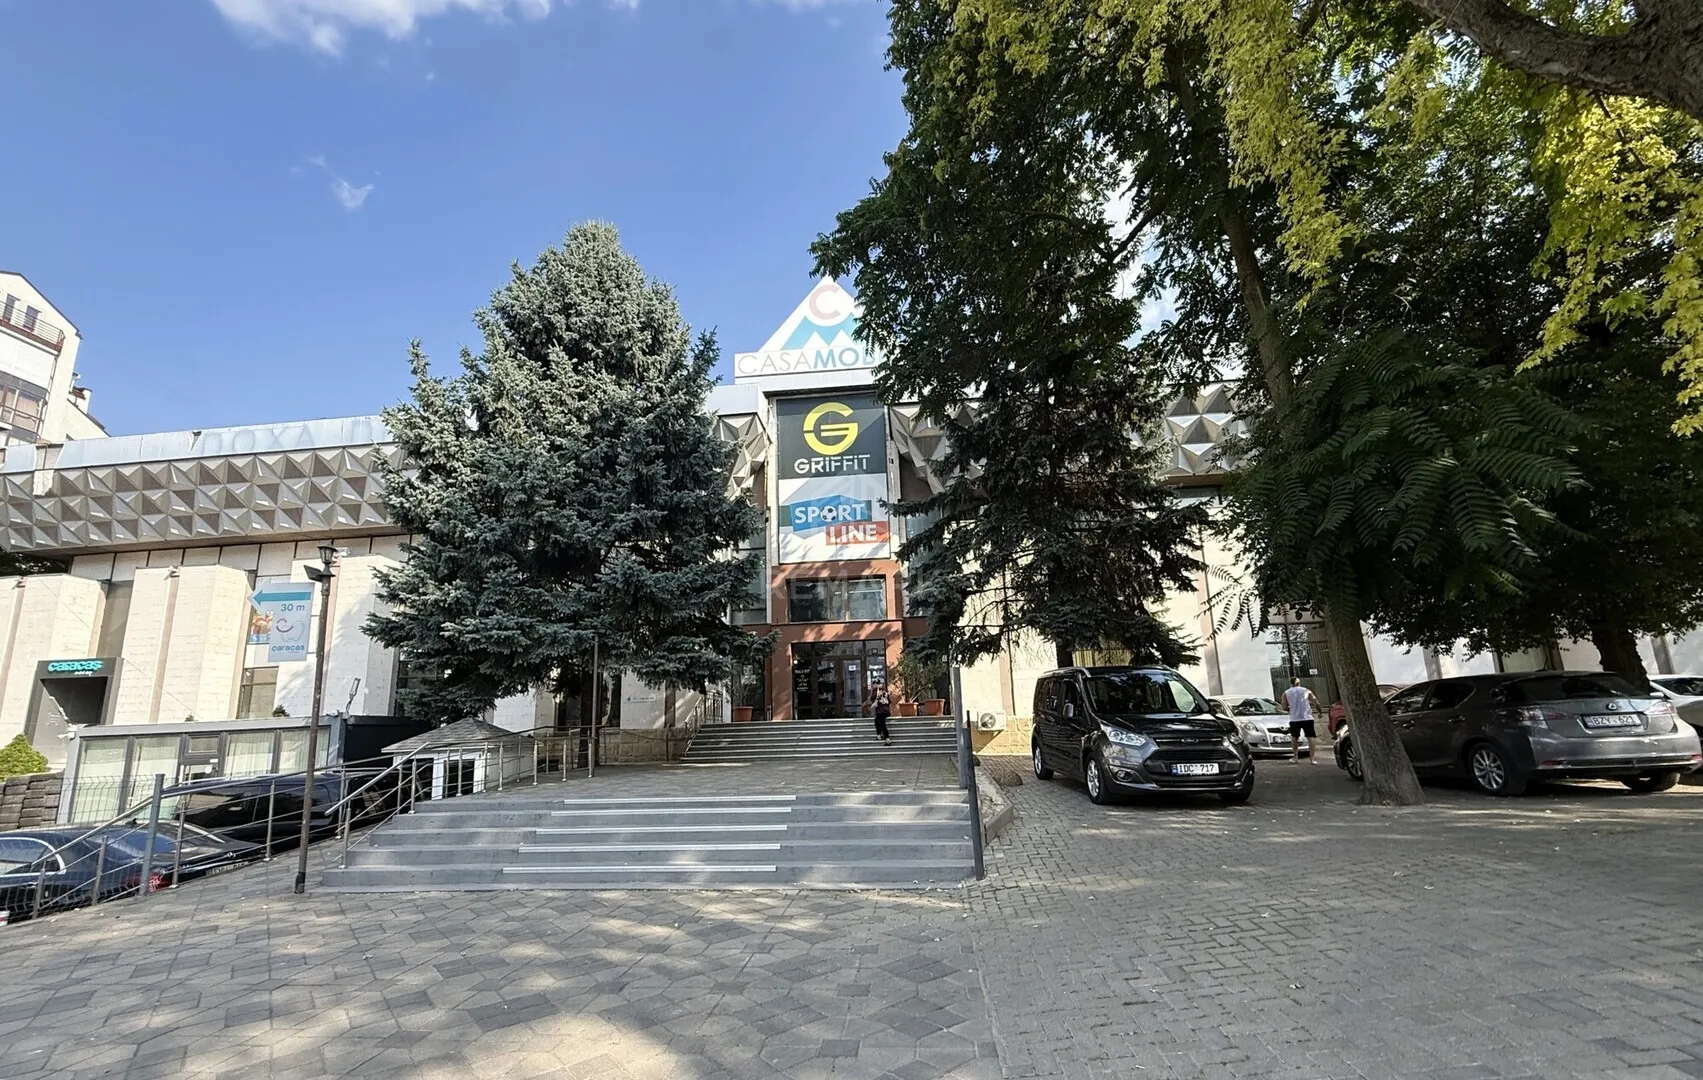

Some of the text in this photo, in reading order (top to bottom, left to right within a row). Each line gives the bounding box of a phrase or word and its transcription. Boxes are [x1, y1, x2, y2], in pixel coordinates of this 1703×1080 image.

[809, 284, 841, 320] C
[794, 503, 866, 524] SPORT
[829, 524, 877, 543] LINE
[280, 603, 305, 612] 30 m
[271, 644, 305, 652] caracas
[48, 660, 104, 672] caracas
[1592, 716, 1635, 726] BZY 621
[1200, 764, 1214, 773] 717
